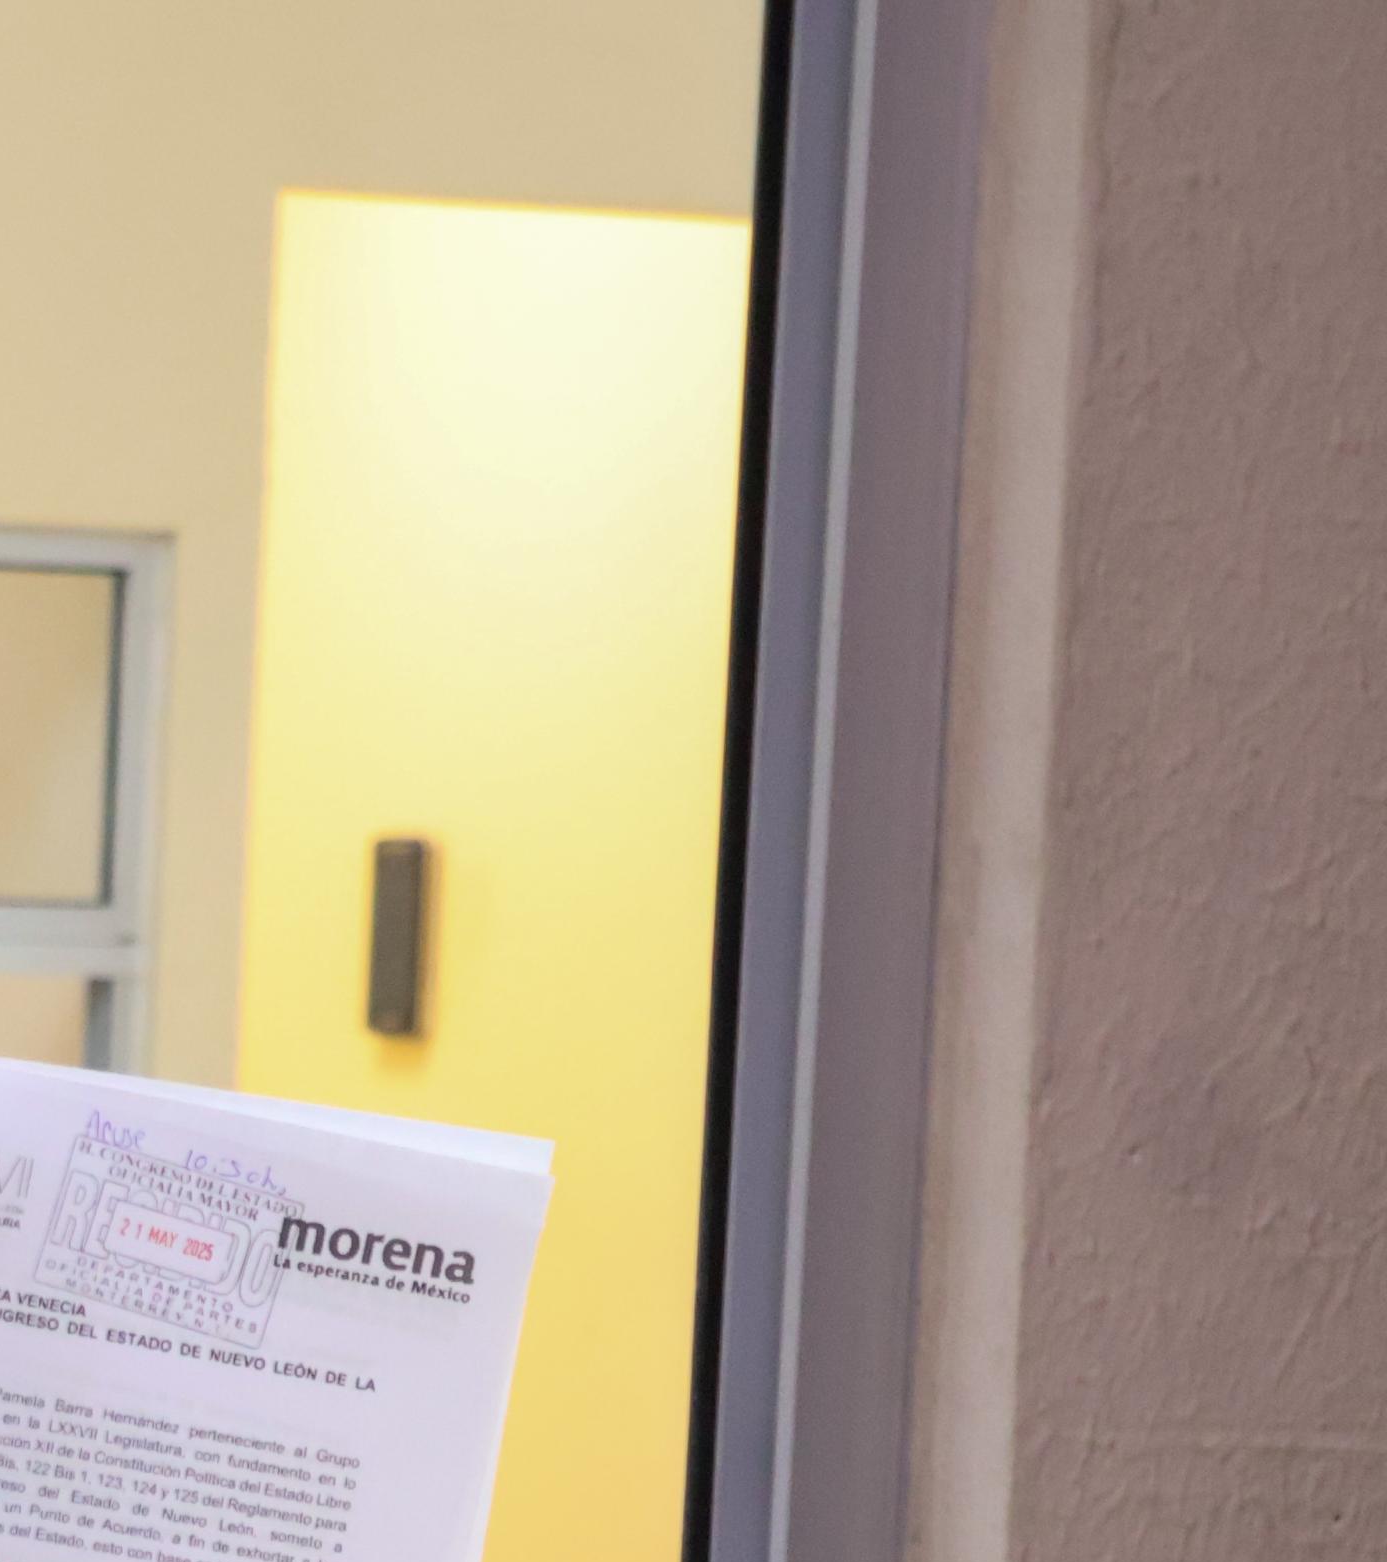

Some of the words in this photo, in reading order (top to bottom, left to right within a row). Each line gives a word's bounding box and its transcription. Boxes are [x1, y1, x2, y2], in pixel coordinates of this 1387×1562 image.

[146, 1226, 178, 1251] MAY
[182, 1237, 215, 1262] 2025
[278, 1216, 475, 1285] morena
[16, 1291, 86, 1317] VENECIA
[273, 1254, 291, 1269] La
[297, 1258, 379, 1287] esperanza
[385, 1276, 405, 1291] de
[411, 1280, 471, 1304] México
[66, 1320, 97, 1339] DEL
[105, 1327, 172, 1353] ESTADO
[179, 1341, 201, 1359] DE
[208, 1347, 266, 1371] NUEVO
[272, 1360, 318, 1381] LEÓN
[324, 1369, 347, 1386] DE
[354, 1375, 375, 1392] LA
[1, 1413, 20, 1426] en
[26, 1415, 40, 1430] la
[47, 1418, 98, 1440] LXXVII
[193, 1449, 221, 1464] con
[226, 1453, 311, 1481] fundamento
[317, 1473, 336, 1486] en
[342, 1475, 356, 1490] lo
[53, 1397, 93, 1418] Barra
[187, 1425, 285, 1455] perteneciente
[292, 1445, 307, 1459] al
[315, 1447, 360, 1469] Grupo
[3, 1502, 21, 1514] un
[28, 1502, 70, 1524] Punto
[76, 1514, 95, 1528] de
[187, 1532, 205, 1549] fin
[211, 1539, 230, 1554] de
[37, 1484, 60, 1499] del
[69, 1488, 120, 1511] Estado
[131, 1502, 150, 1517] de
[160, 1506, 207, 1528] Nuevo
[269, 1529, 323, 1549] someto
